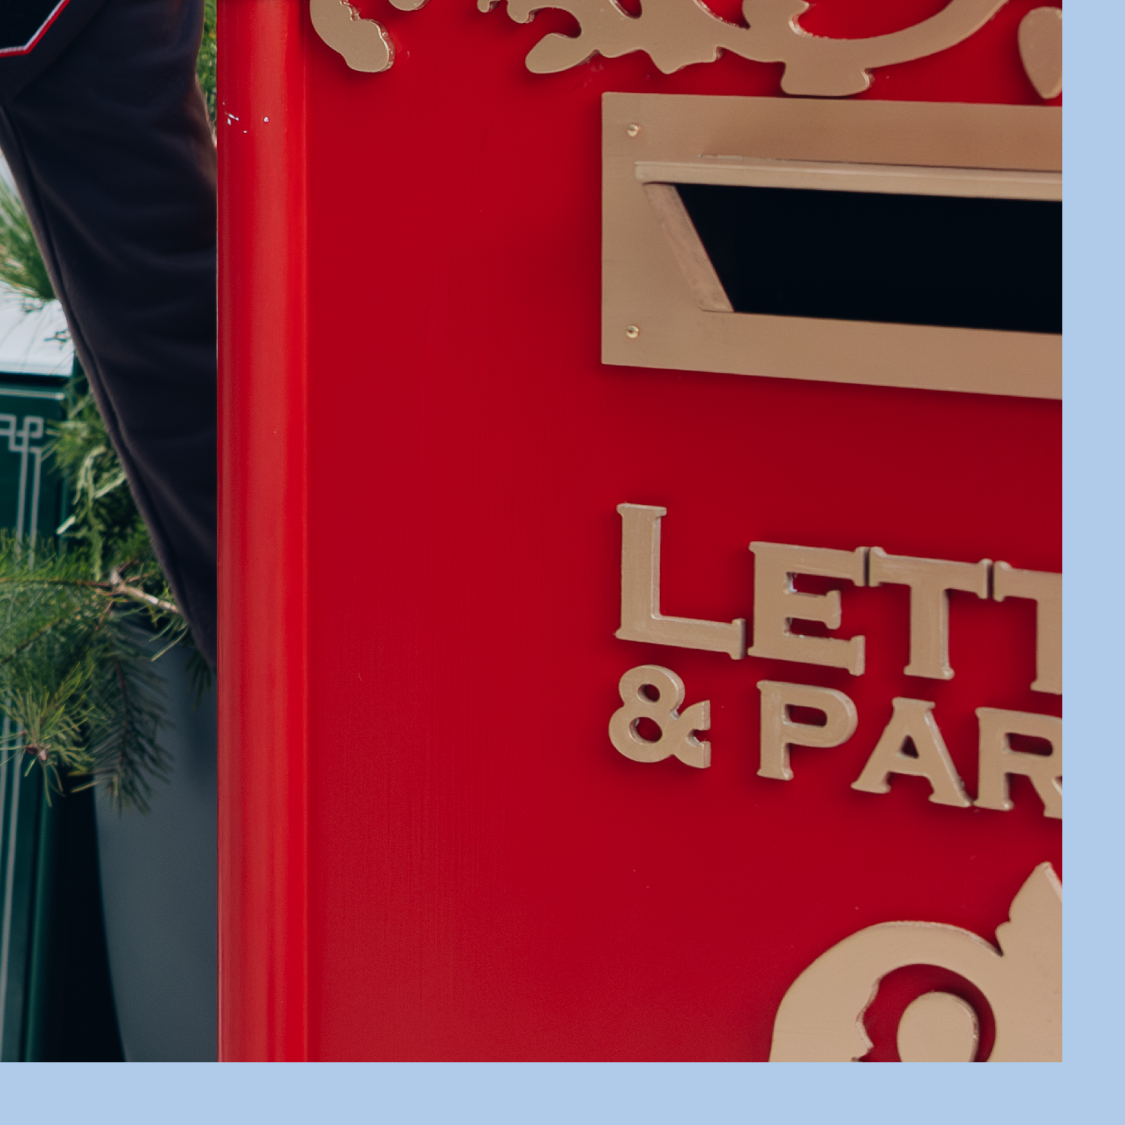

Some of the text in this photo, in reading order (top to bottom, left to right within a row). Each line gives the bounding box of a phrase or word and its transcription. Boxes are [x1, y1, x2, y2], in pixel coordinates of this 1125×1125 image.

[614, 503, 1062, 695] LETT
[608, 664, 1062, 819] & PAR
